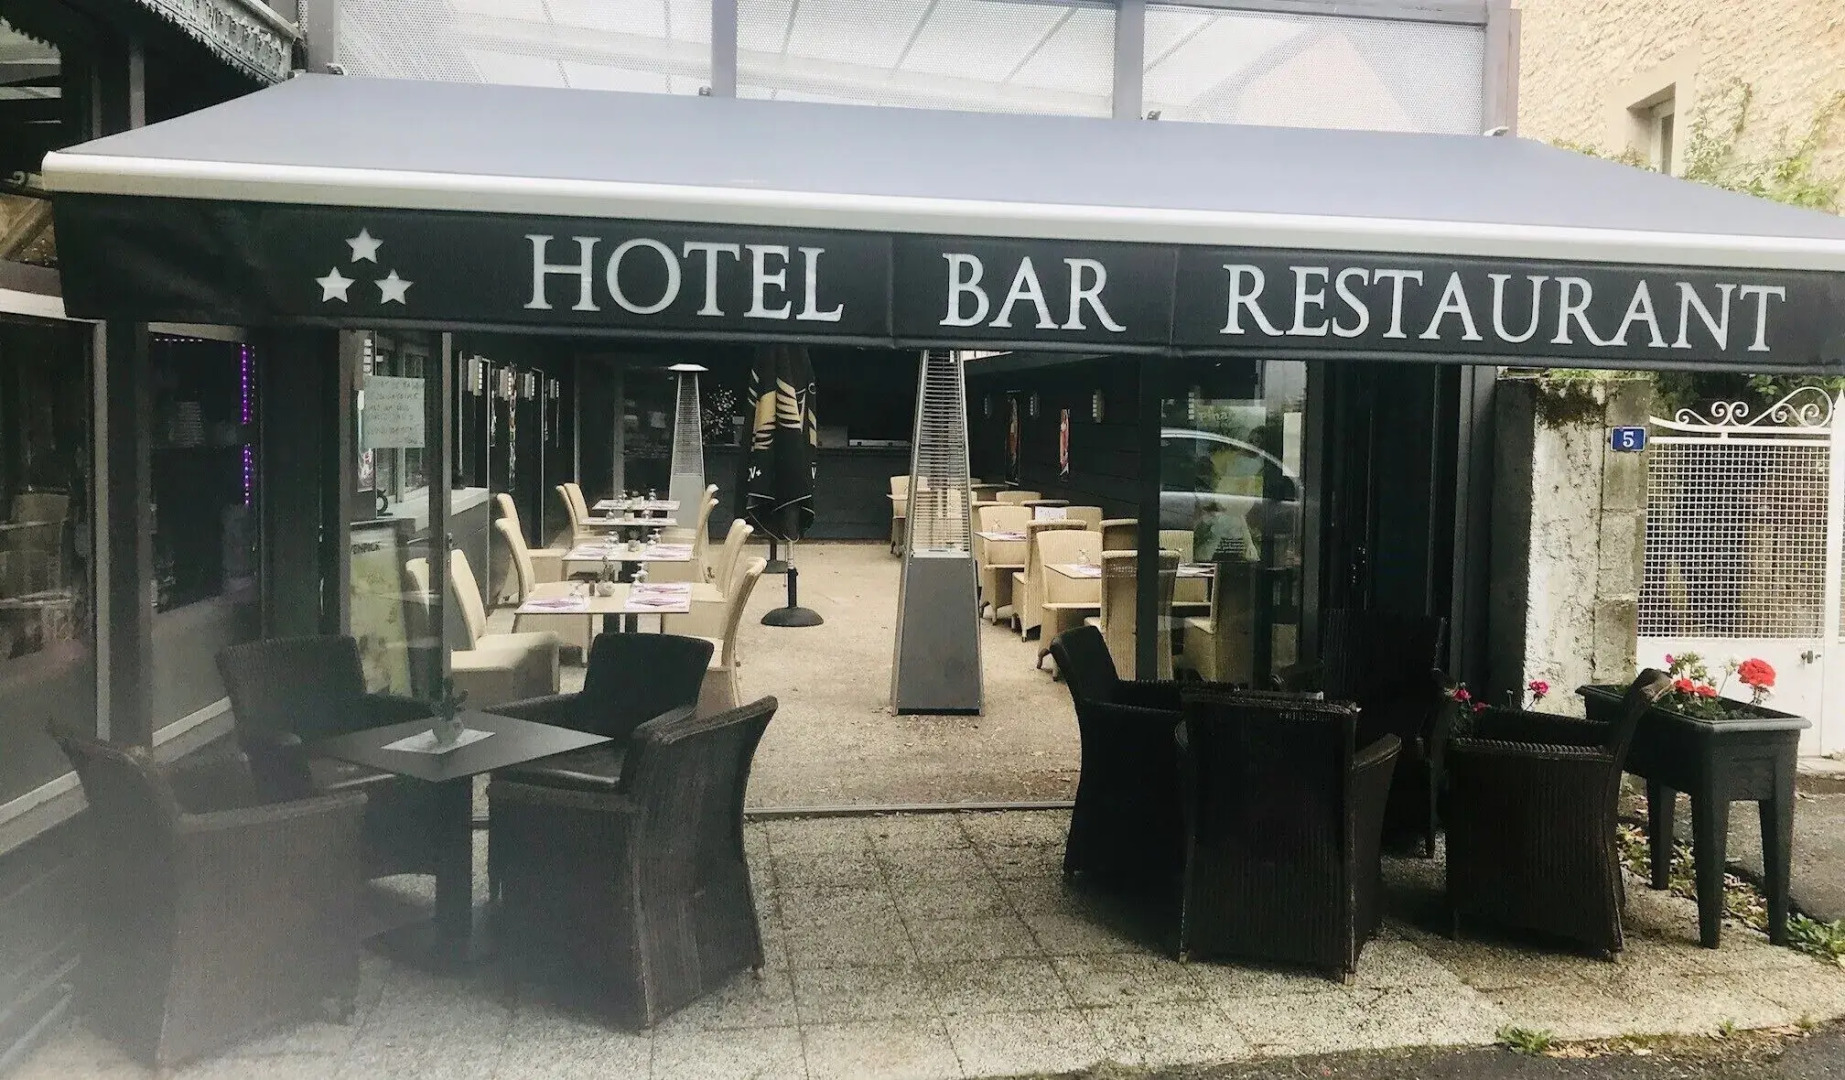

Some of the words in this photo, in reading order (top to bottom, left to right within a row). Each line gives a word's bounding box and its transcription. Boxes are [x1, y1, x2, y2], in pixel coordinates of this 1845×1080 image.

[523, 234, 844, 322] HOTEL
[939, 252, 1127, 332] BAR
[1219, 263, 1786, 352] RESTAURANT
[1622, 430, 1635, 448] 5
